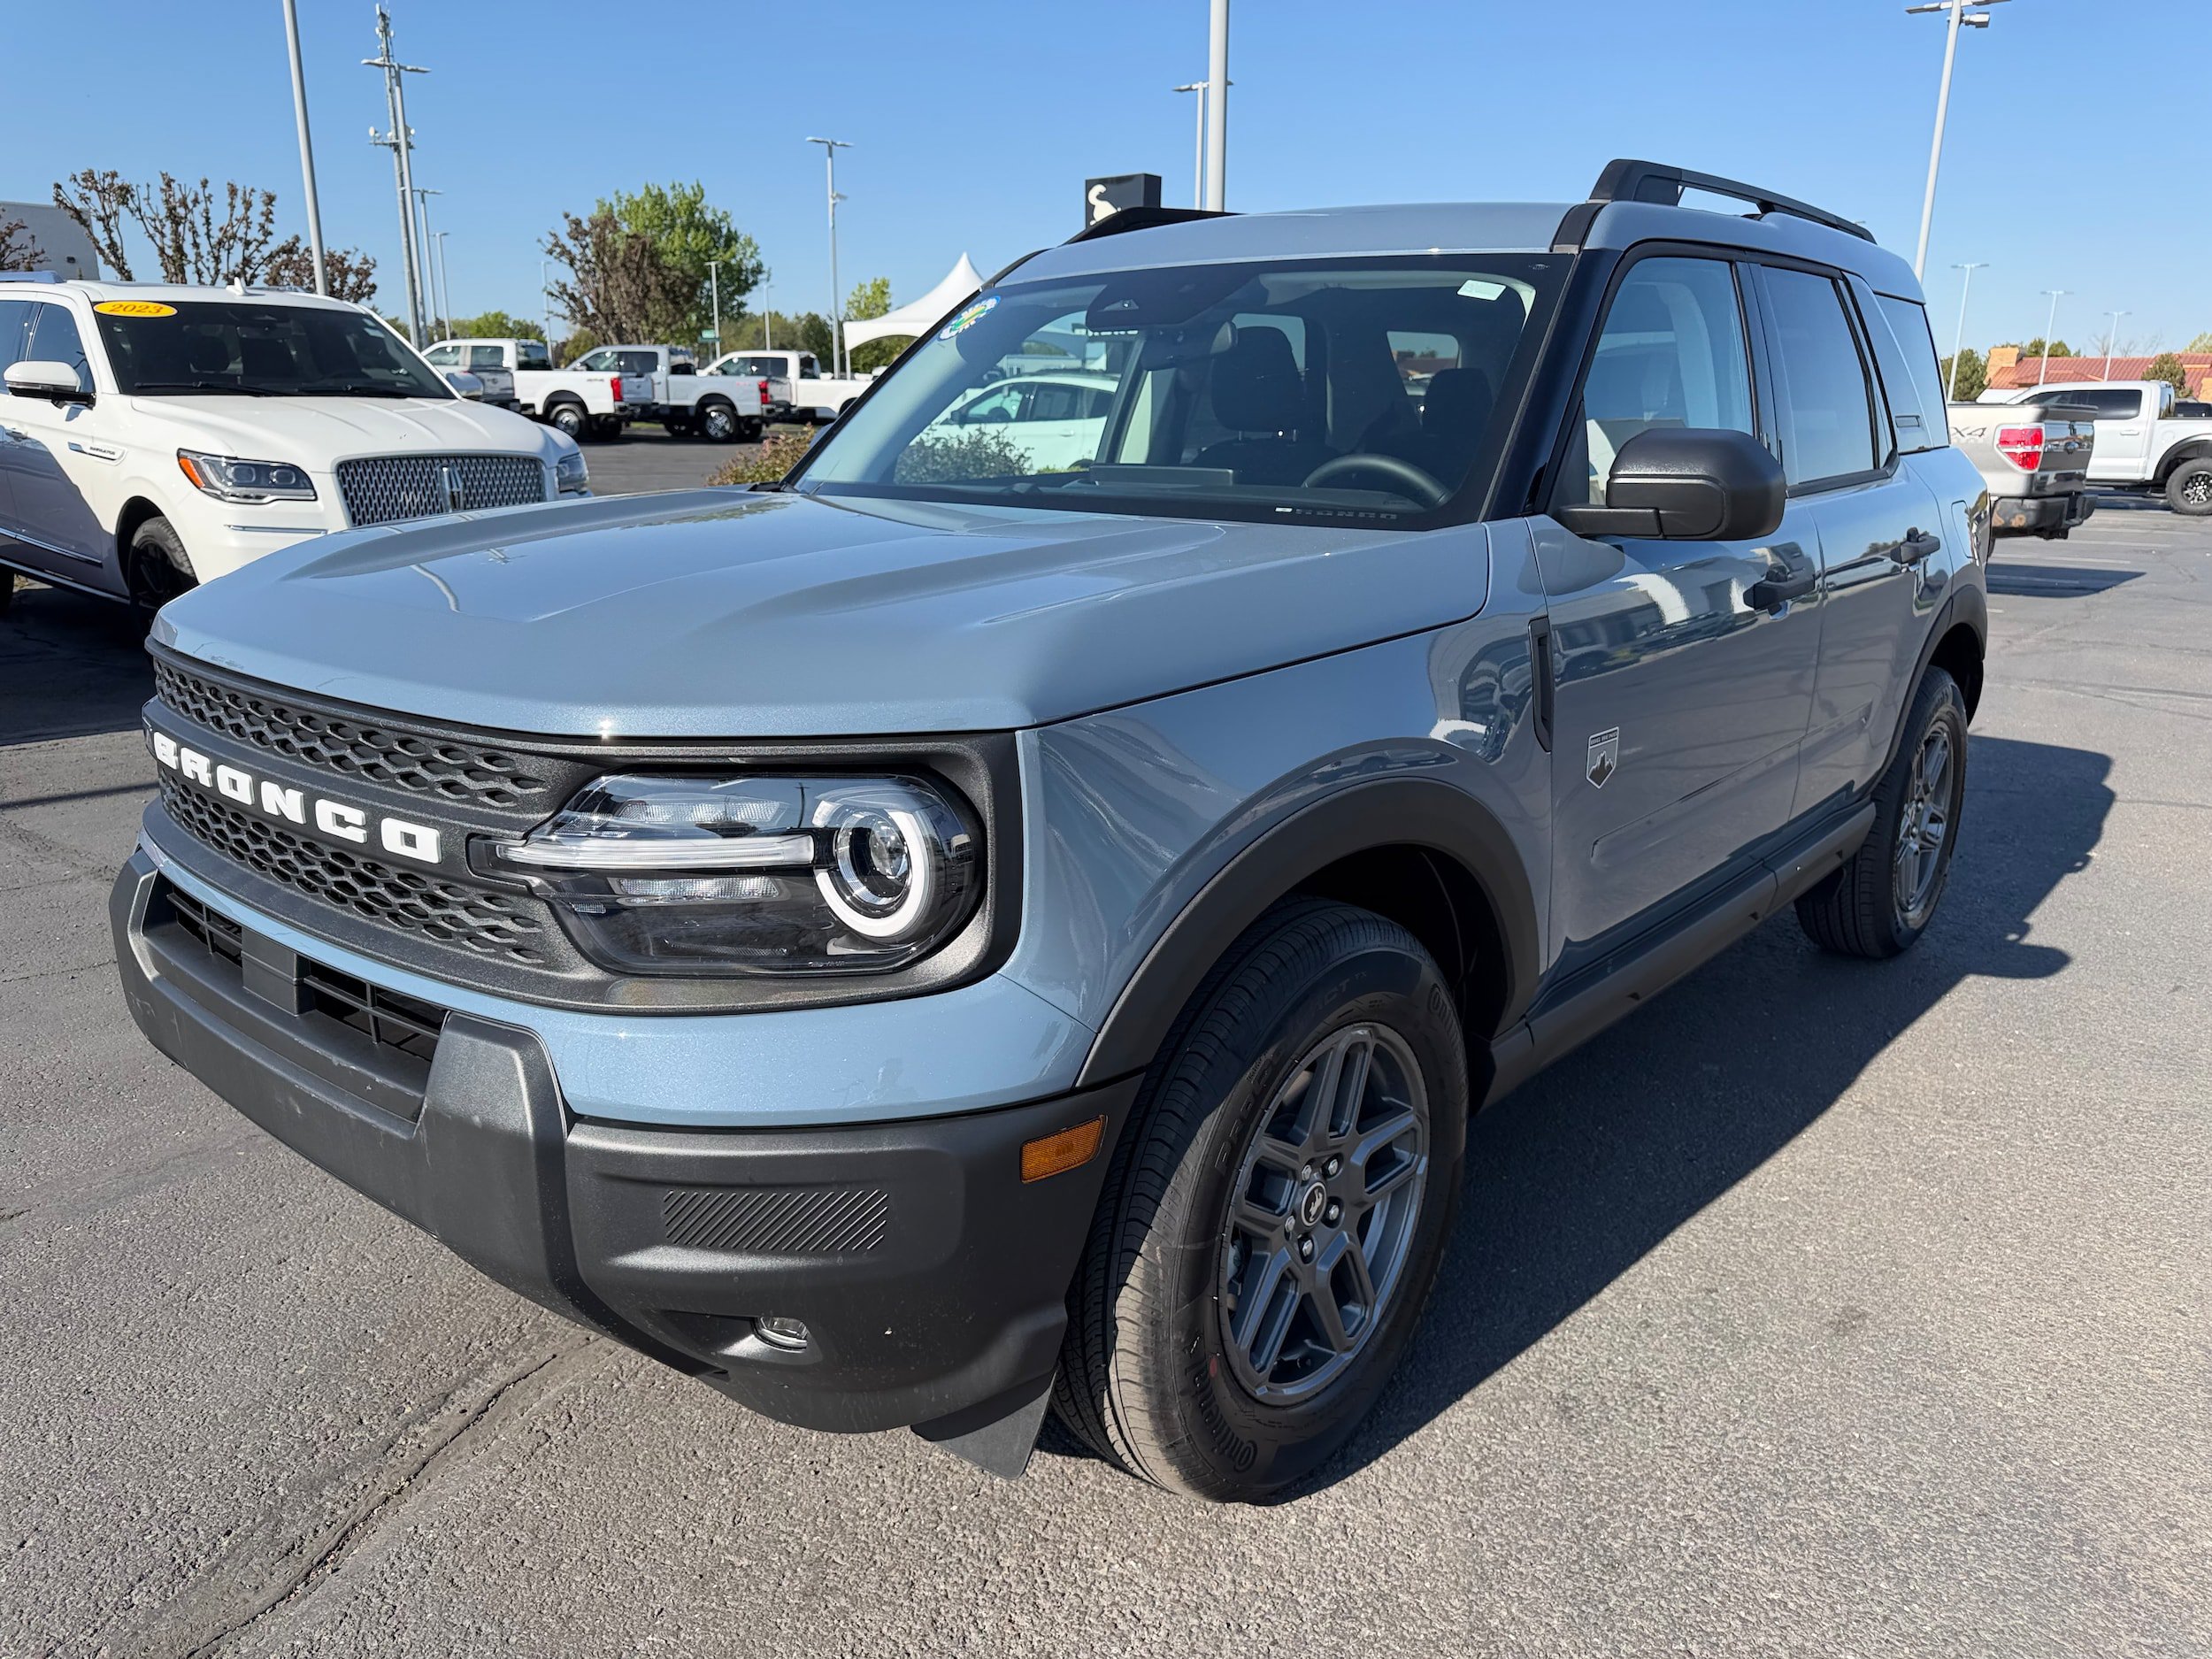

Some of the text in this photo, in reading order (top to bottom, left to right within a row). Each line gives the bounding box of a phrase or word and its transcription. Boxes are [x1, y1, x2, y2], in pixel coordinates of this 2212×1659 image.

[108, 303, 164, 314] 2023
[1950, 426, 1987, 438] X4
[153, 732, 441, 864] BRONCO
